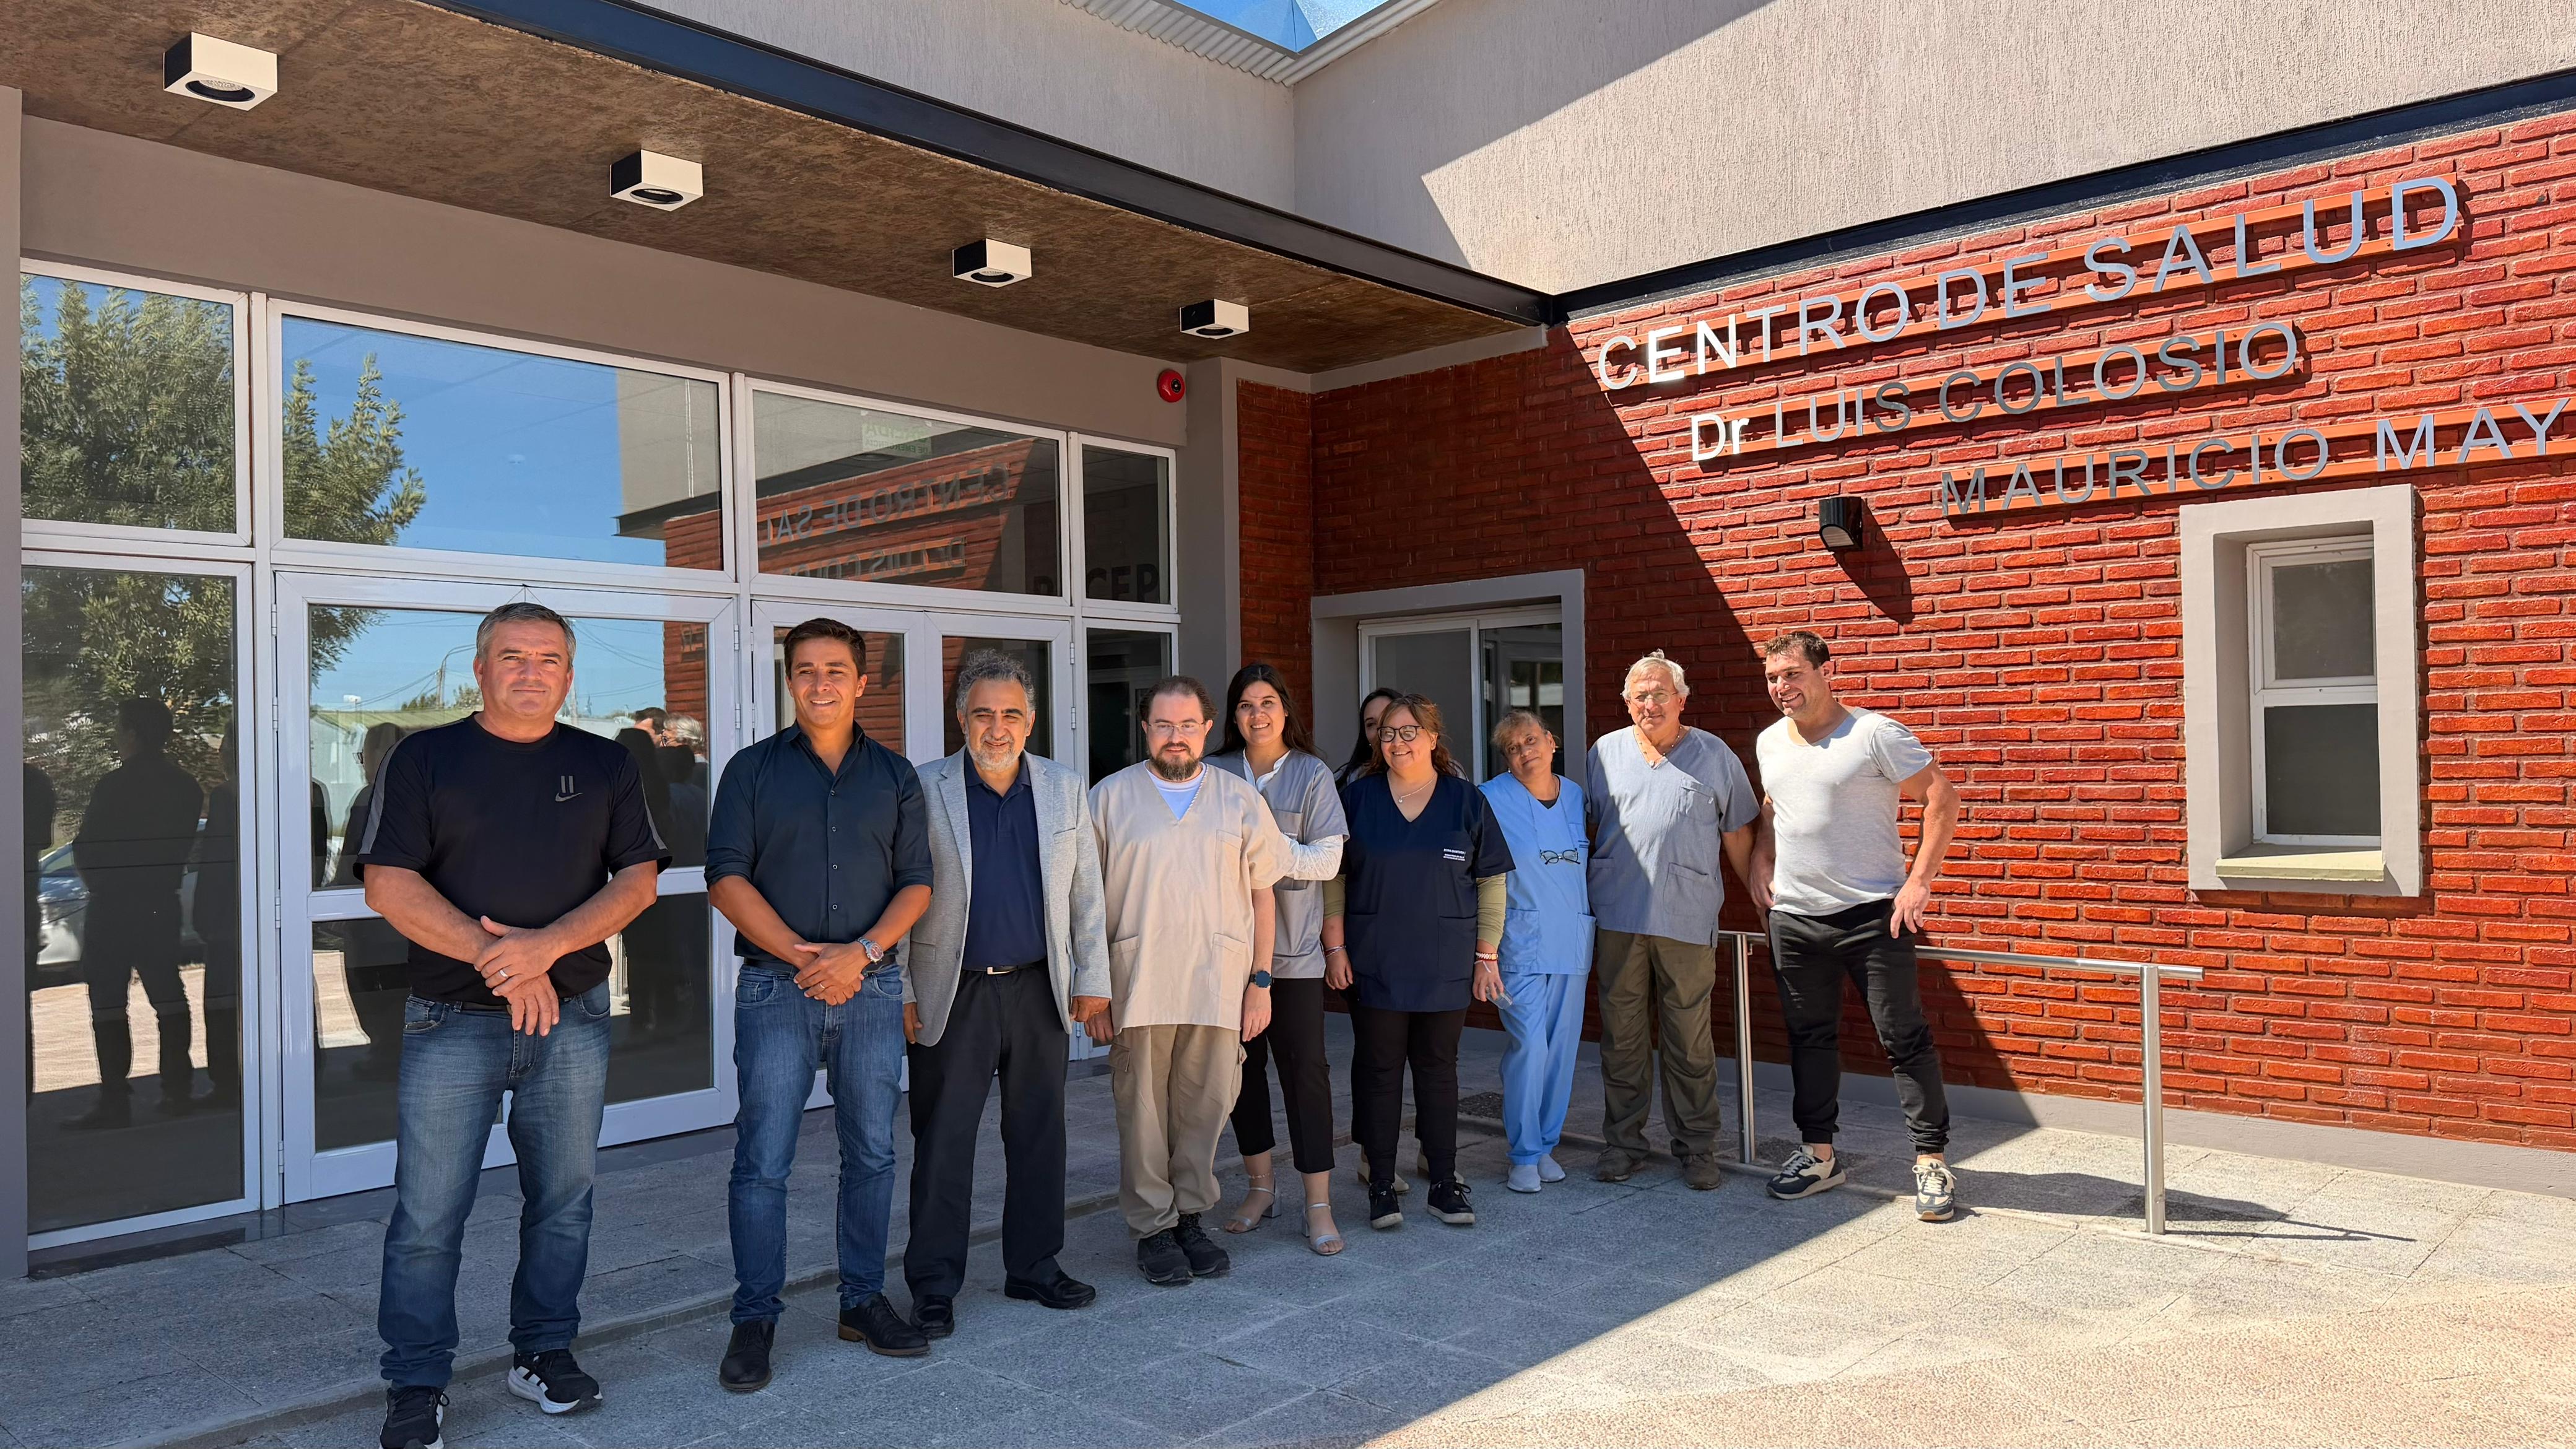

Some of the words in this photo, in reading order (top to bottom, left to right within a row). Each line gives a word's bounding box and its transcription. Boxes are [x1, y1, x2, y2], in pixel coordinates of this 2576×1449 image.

[1598, 281, 1909, 391] CENTRO
[1938, 252, 2051, 329] DE
[2084, 176, 2458, 302] SALUD
[1691, 413, 1749, 461] Dr
[1775, 382, 1910, 448] LUIS
[1939, 322, 2297, 422] COLOSIO
[1942, 429, 2328, 517] MAURICIO
[2376, 398, 2570, 472] MAY
